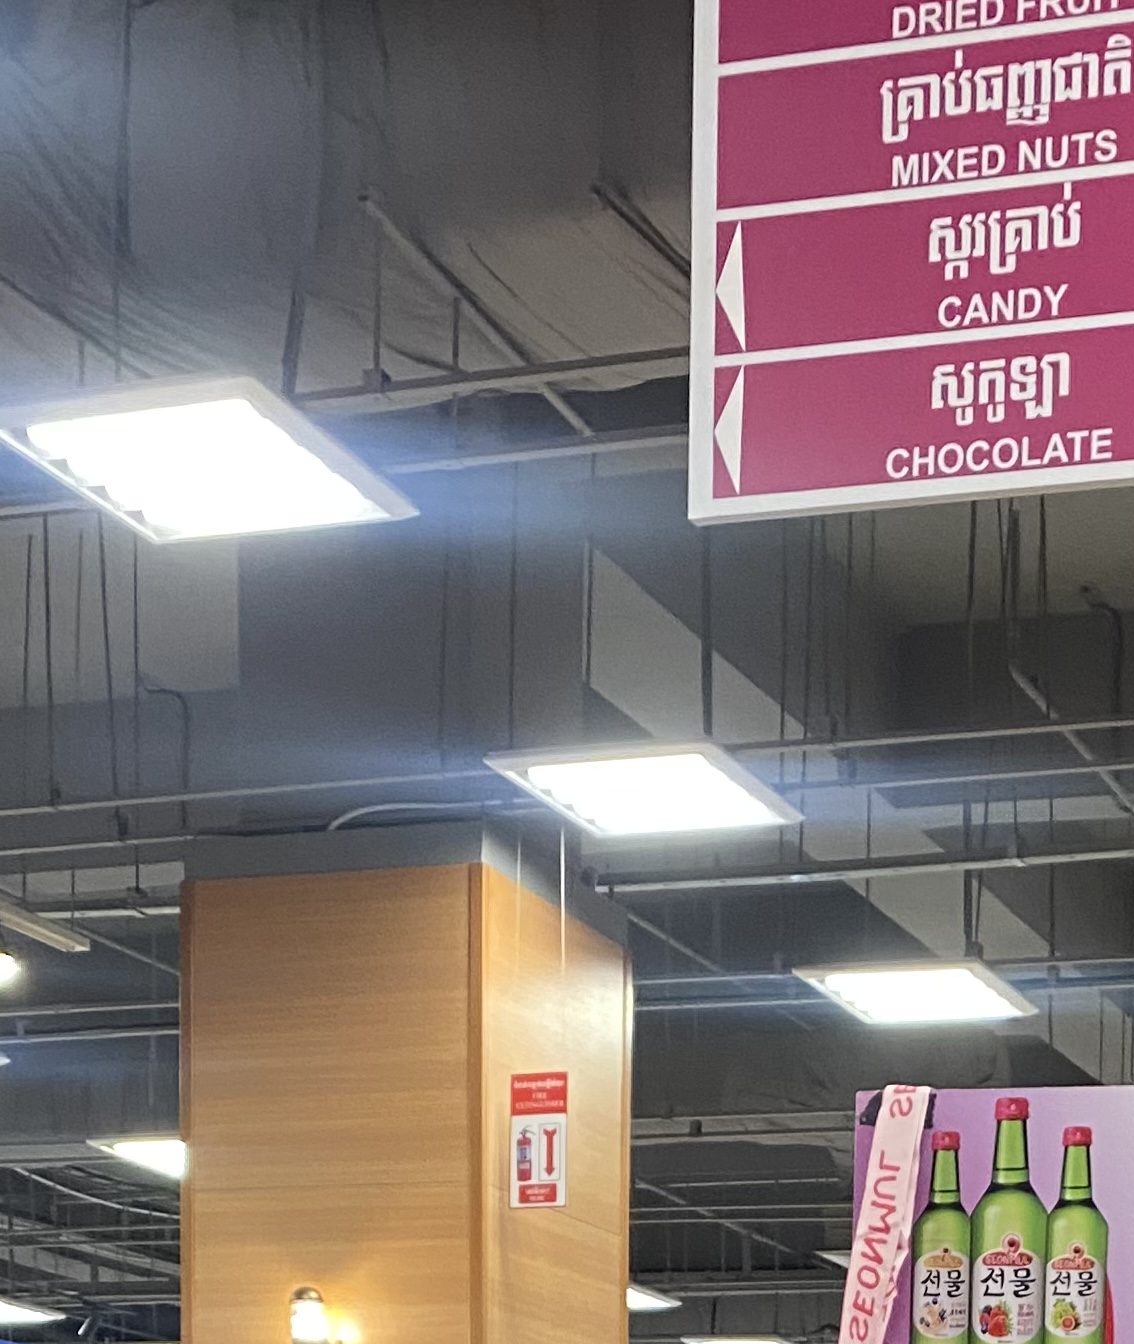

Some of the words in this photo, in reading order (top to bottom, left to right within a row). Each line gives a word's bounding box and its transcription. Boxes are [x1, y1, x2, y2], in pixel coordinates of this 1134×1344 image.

[891, 0, 1004, 39] DRIED
[891, 143, 1006, 187] MIXED
[1017, 129, 1118, 173] NUTS
[928, 183, 1082, 280] ស្ករគ្រាប់
[937, 284, 1069, 329] CANDY
[931, 353, 1071, 425] សូកូឡា
[885, 428, 1114, 480] CHOCOLATE
